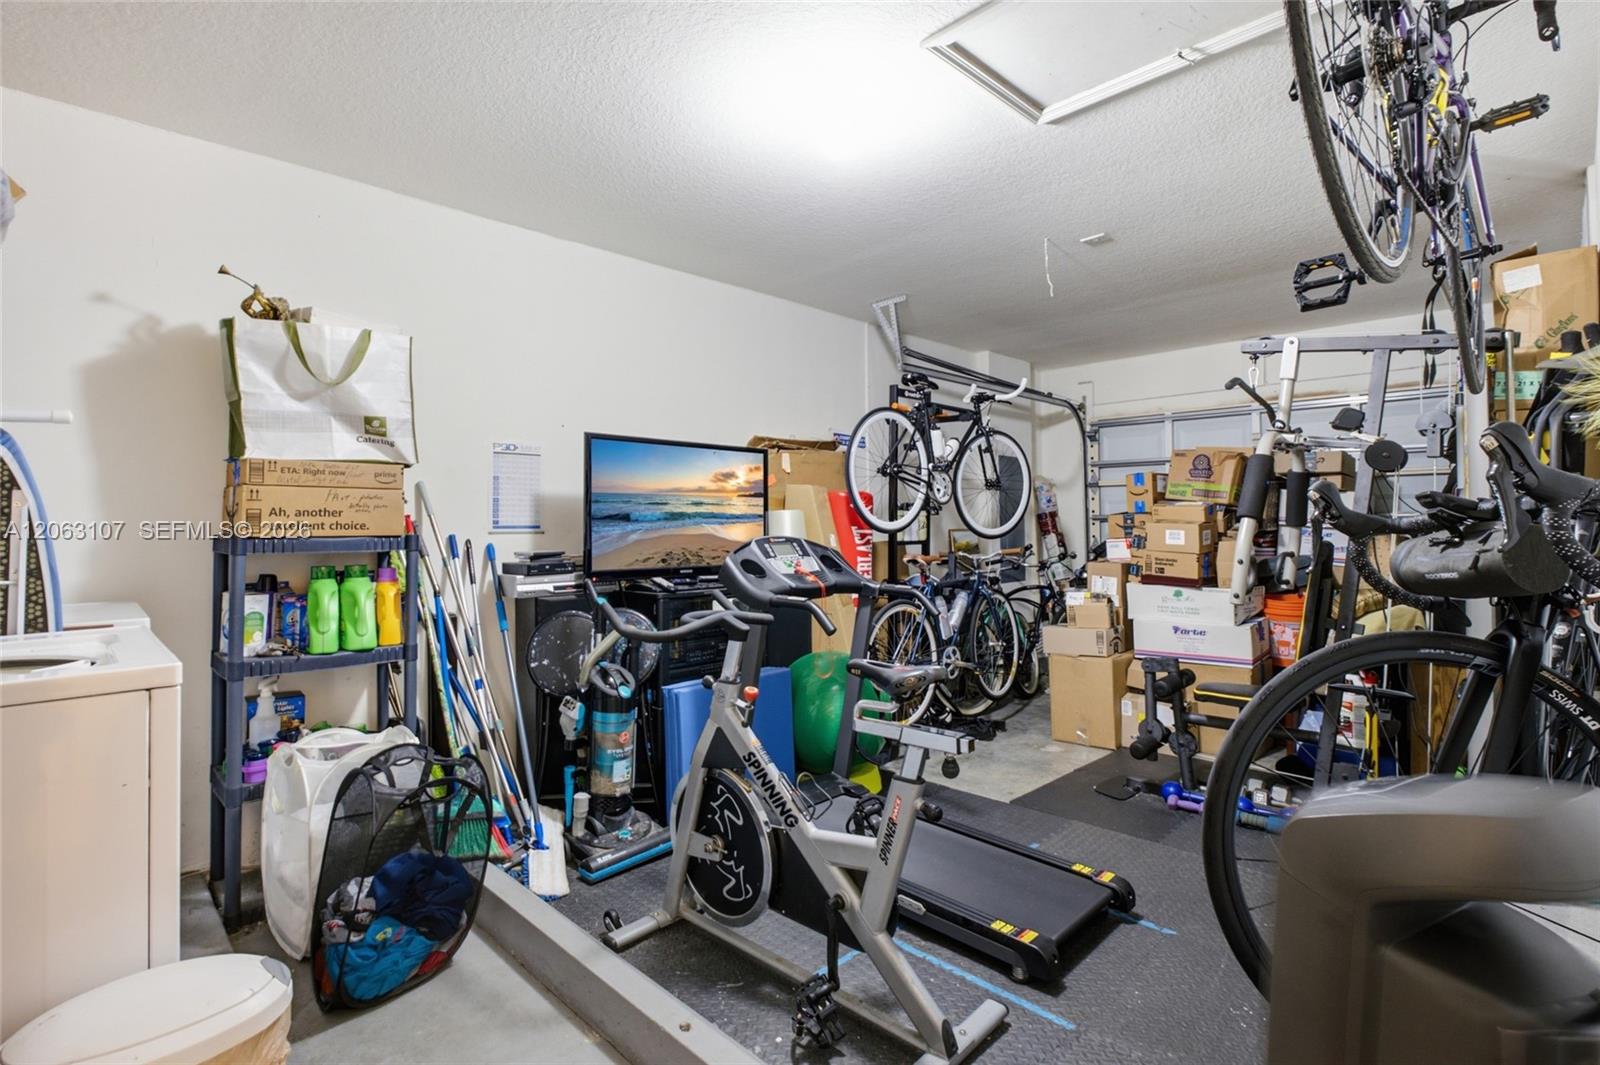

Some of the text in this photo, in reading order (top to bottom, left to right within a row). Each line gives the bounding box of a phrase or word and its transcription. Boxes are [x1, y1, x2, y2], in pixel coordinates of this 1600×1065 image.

[356, 435, 395, 448] Catering
[280, 467, 300, 475] ETA:
[302, 467, 326, 477] Right
[374, 471, 398, 479] prime
[268, 506, 344, 519] Ah, another
[328, 521, 370, 531] choice.
[1548, 689, 1600, 731] DT SWISS
[742, 751, 799, 829] SPINNING
[879, 815, 898, 866] SPINNER
